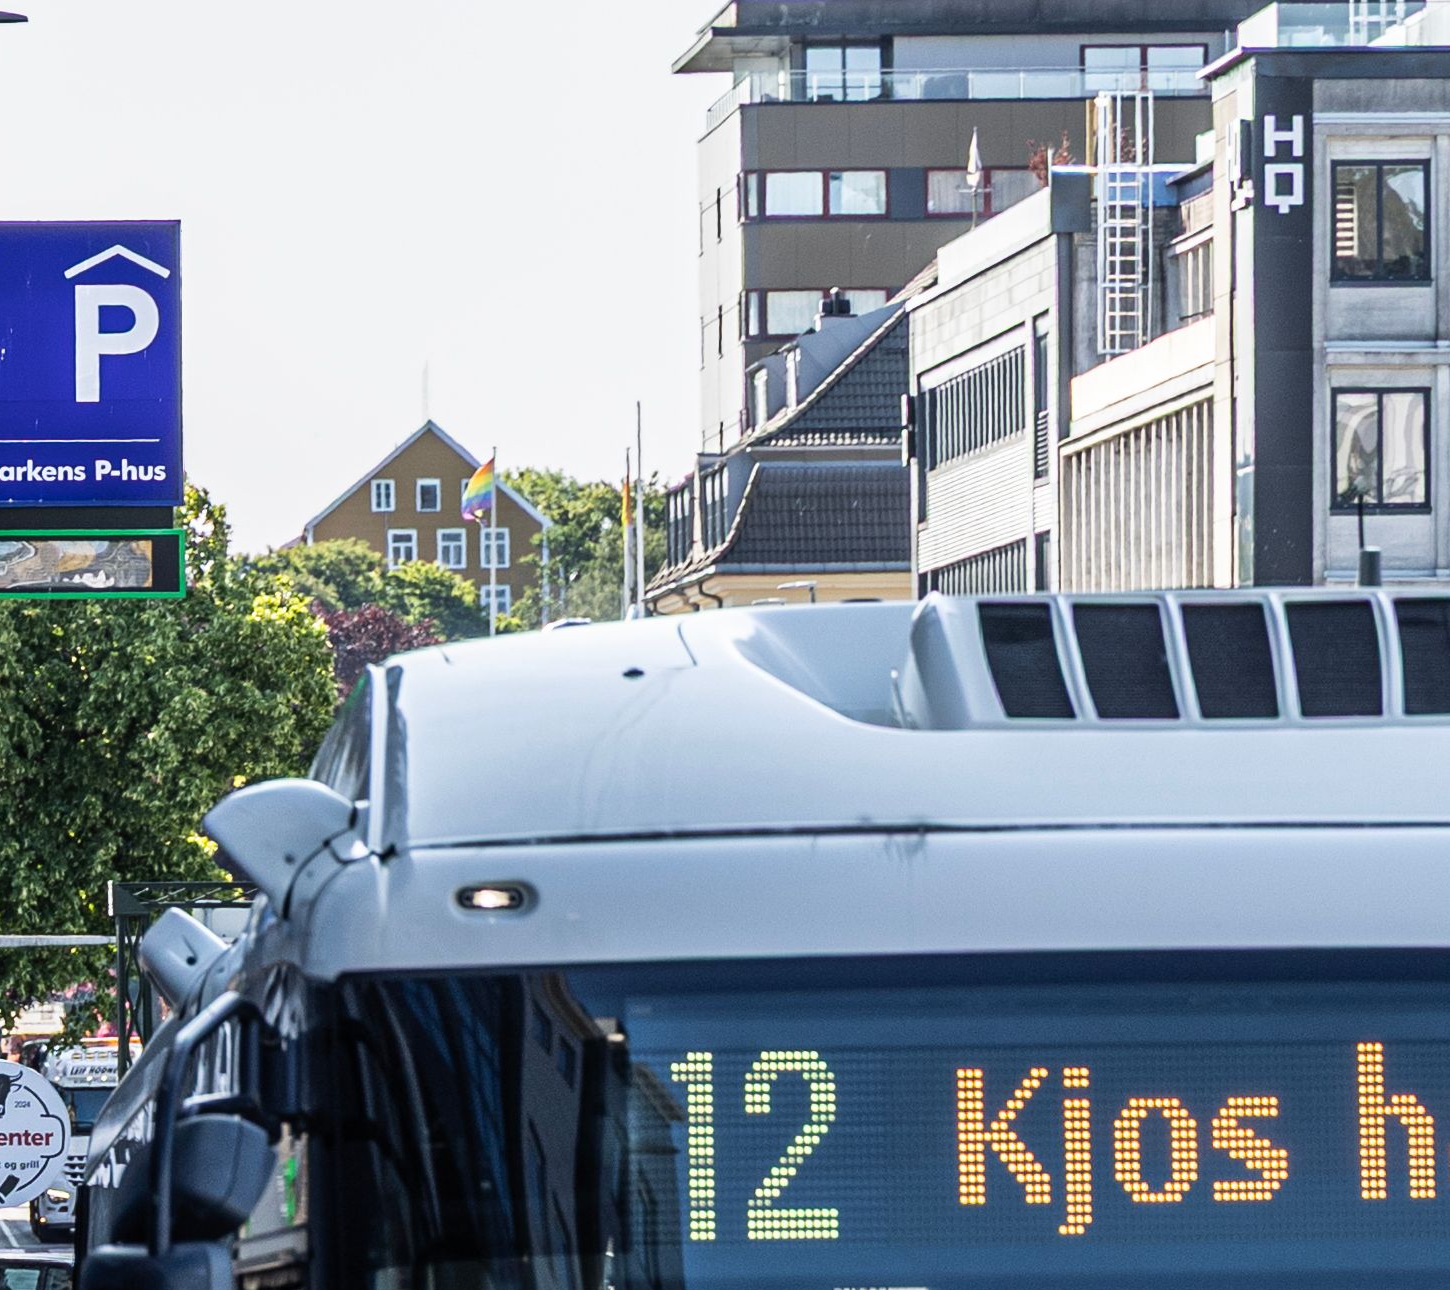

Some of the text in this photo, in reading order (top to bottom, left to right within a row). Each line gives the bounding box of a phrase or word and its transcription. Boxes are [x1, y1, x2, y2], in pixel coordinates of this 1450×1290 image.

[1263, 114, 1304, 214] HQ
[74, 284, 160, 402] P
[95, 459, 166, 481] P-hus
[4, 1162, 17, 1170] og
[20, 1161, 40, 1170] grill
[671, 1050, 839, 1241] 12
[955, 1065, 1290, 1236] Kjos
